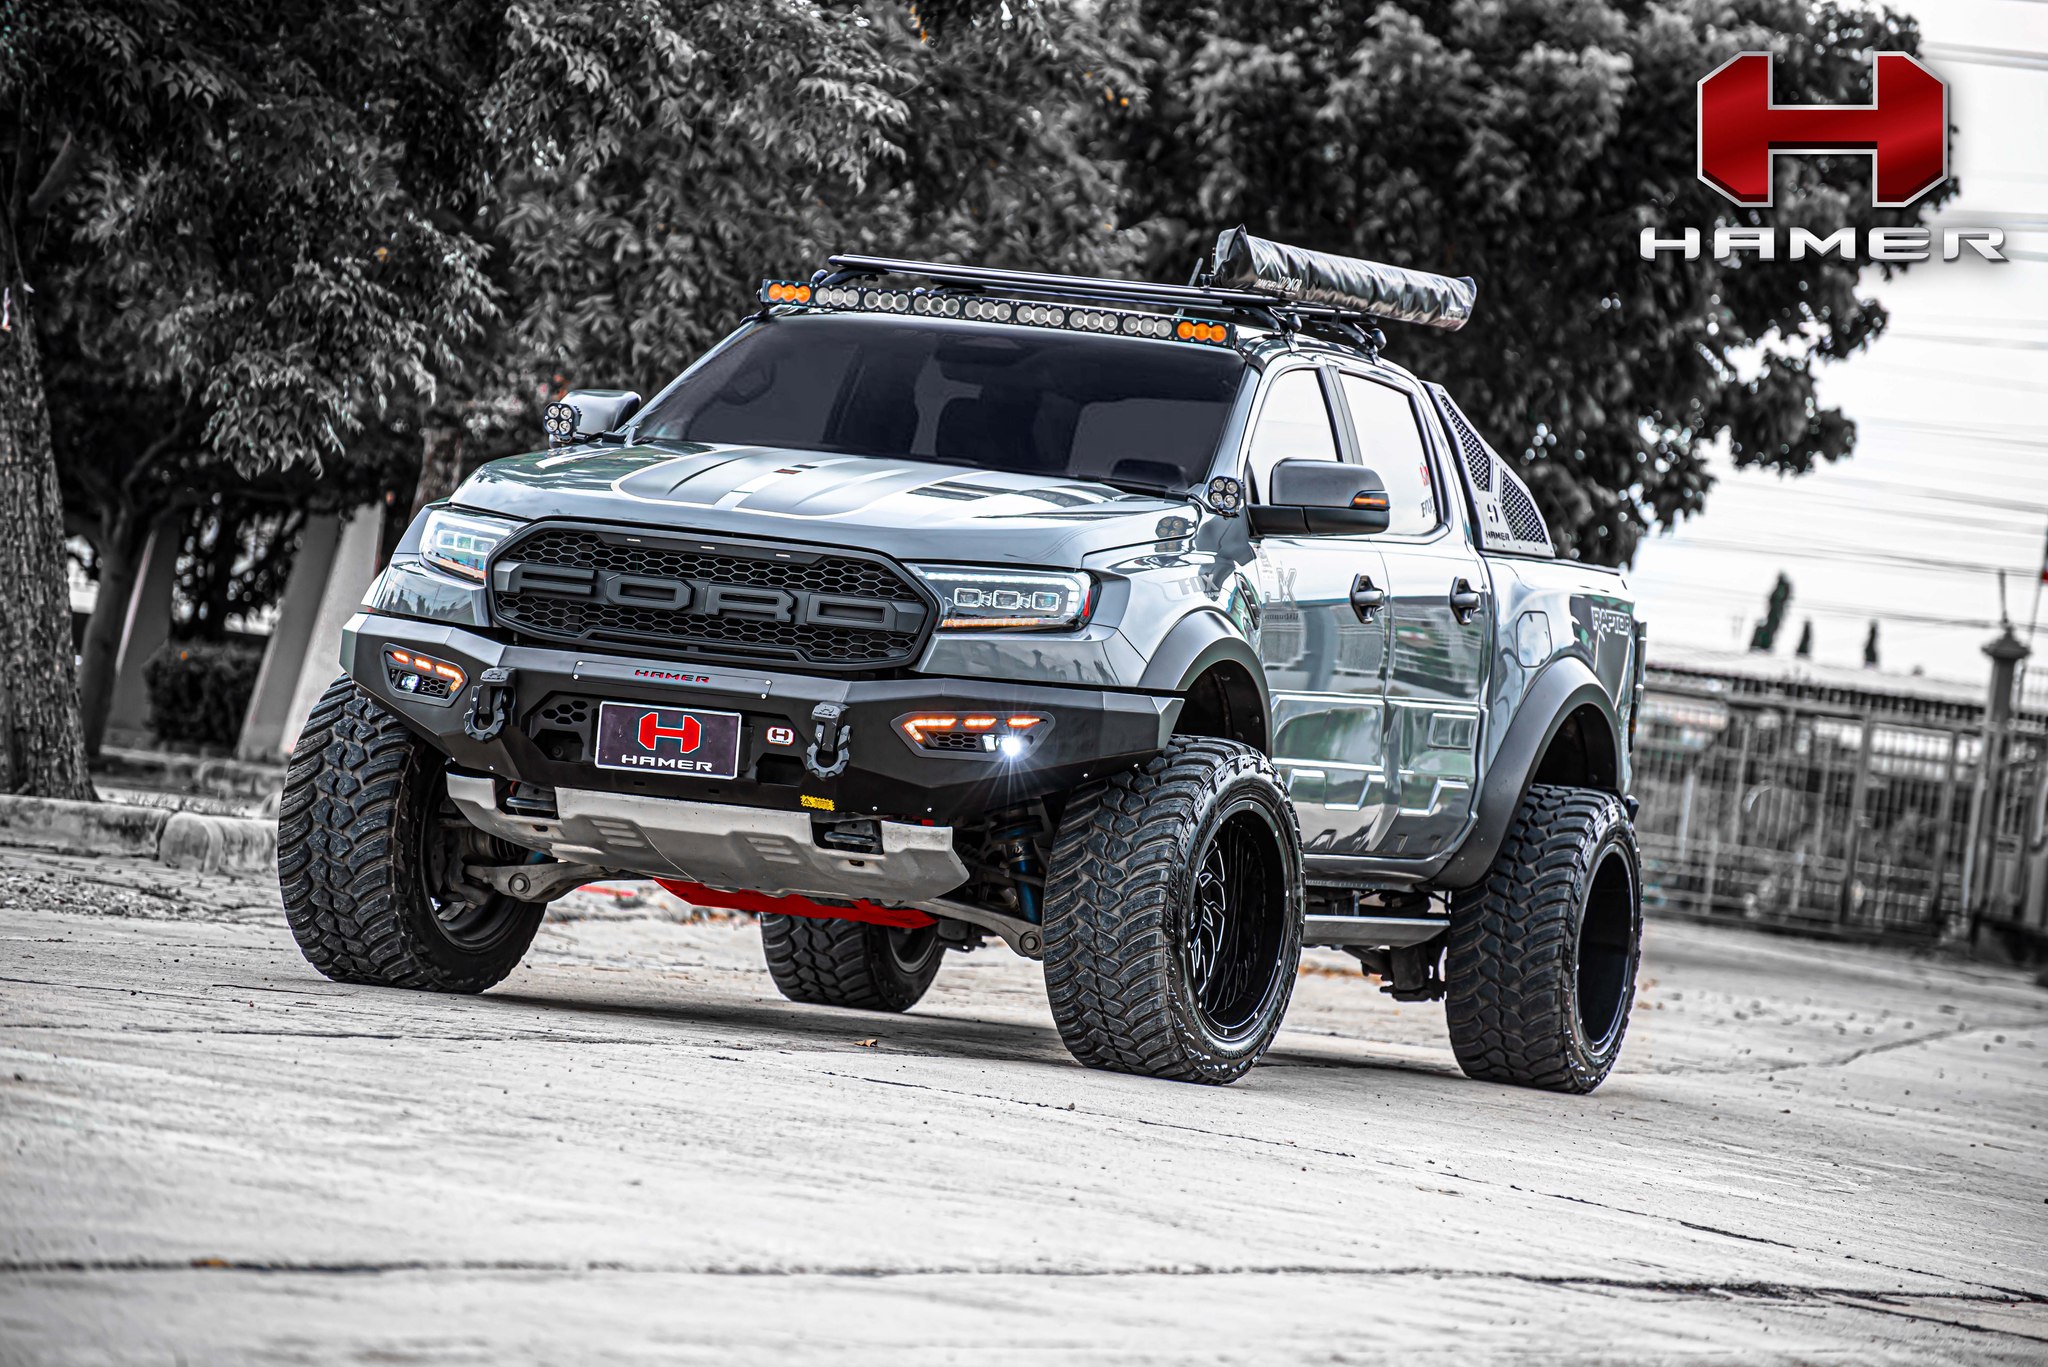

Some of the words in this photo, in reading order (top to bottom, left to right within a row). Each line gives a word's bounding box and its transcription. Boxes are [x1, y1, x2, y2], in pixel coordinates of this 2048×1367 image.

[1485, 530, 1511, 541] HAMER
[494, 560, 927, 634] FORD
[1591, 606, 1632, 640] RAPTOR
[634, 669, 710, 683] HAMER
[621, 753, 713, 773] HAMER
